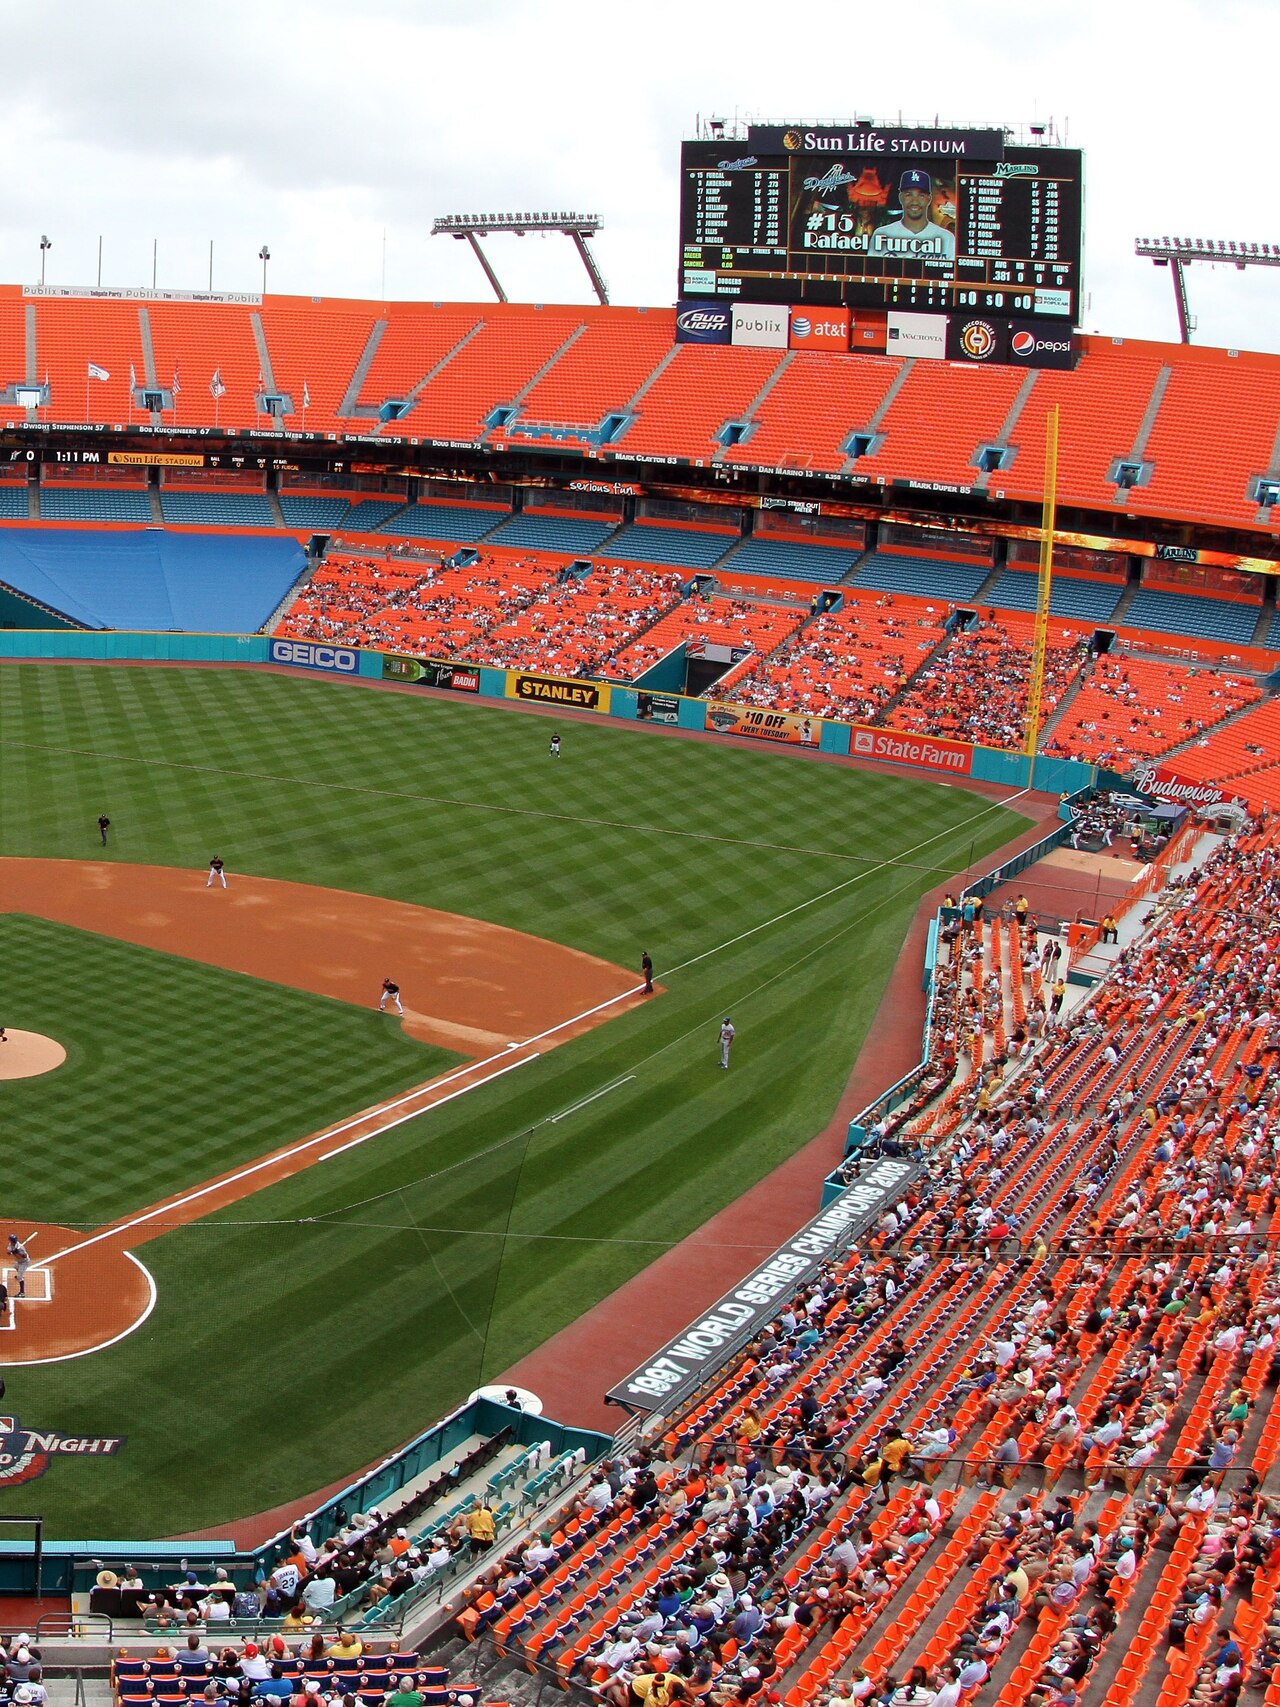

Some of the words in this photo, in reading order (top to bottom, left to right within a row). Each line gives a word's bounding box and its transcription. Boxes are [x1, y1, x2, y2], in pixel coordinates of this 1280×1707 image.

[804, 132, 843, 151] Sun
[847, 133, 885, 152] Life
[891, 139, 965, 154] STADIUM
[806, 212, 854, 232] #15
[803, 231, 869, 250] Rafael
[874, 235, 942, 254] Furcal
[958, 258, 984, 267] SCORING
[1052, 264, 1069, 273] RUNS
[23, 287, 57, 296] Publix
[125, 290, 159, 299] Publix
[227, 294, 260, 303] Publix
[690, 313, 726, 322] BUD
[735, 318, 781, 332] Publix
[682, 322, 728, 330] LIGHT
[814, 321, 847, 338] at&t
[961, 319, 995, 335] MICCOSUKEE
[901, 333, 943, 342] WACHOVIA
[1035, 339, 1071, 353] pepsi
[52, 423, 94, 431] STEPHENSON
[26, 450, 34, 460] 0
[56, 451, 81, 462] 1:11
[82, 452, 100, 463] PM
[123, 454, 143, 464] Sun
[144, 454, 163, 464] Life
[164, 458, 201, 466] STADIUM
[615, 453, 634, 461] MARK
[635, 454, 666, 463] CLAYTON
[666, 456, 677, 465] 83
[758, 465, 774, 473] DAN
[775, 467, 804, 476] MARINO
[805, 469, 813, 477] 13
[569, 480, 610, 493] serious
[612, 482, 636, 496] fun.
[909, 479, 932, 491] MARK
[933, 482, 959, 493] DUPER
[960, 485, 971, 494] 85
[1156, 543, 1198, 562] MARLINS
[272, 640, 356, 671] GEICO
[453, 675, 476, 688] BADIA
[521, 681, 594, 704] STANLEY
[745, 710, 763, 727] $10
[765, 714, 787, 729] OFF
[740, 724, 759, 737] EVERY
[759, 727, 790, 740] TUESDAY!
[1003, 753, 1020, 763] 345
[1132, 768, 1223, 803] Budweiser
[626, 1356, 691, 1398] 1997
[667, 1302, 756, 1361] WORLD
[734, 1253, 812, 1305] SERIES
[790, 1184, 886, 1256] CHAMPIONS
[872, 1160, 911, 1189] 2003
[18, 1430, 120, 1452] NIGHT
[281, 1577, 295, 1589] 23
